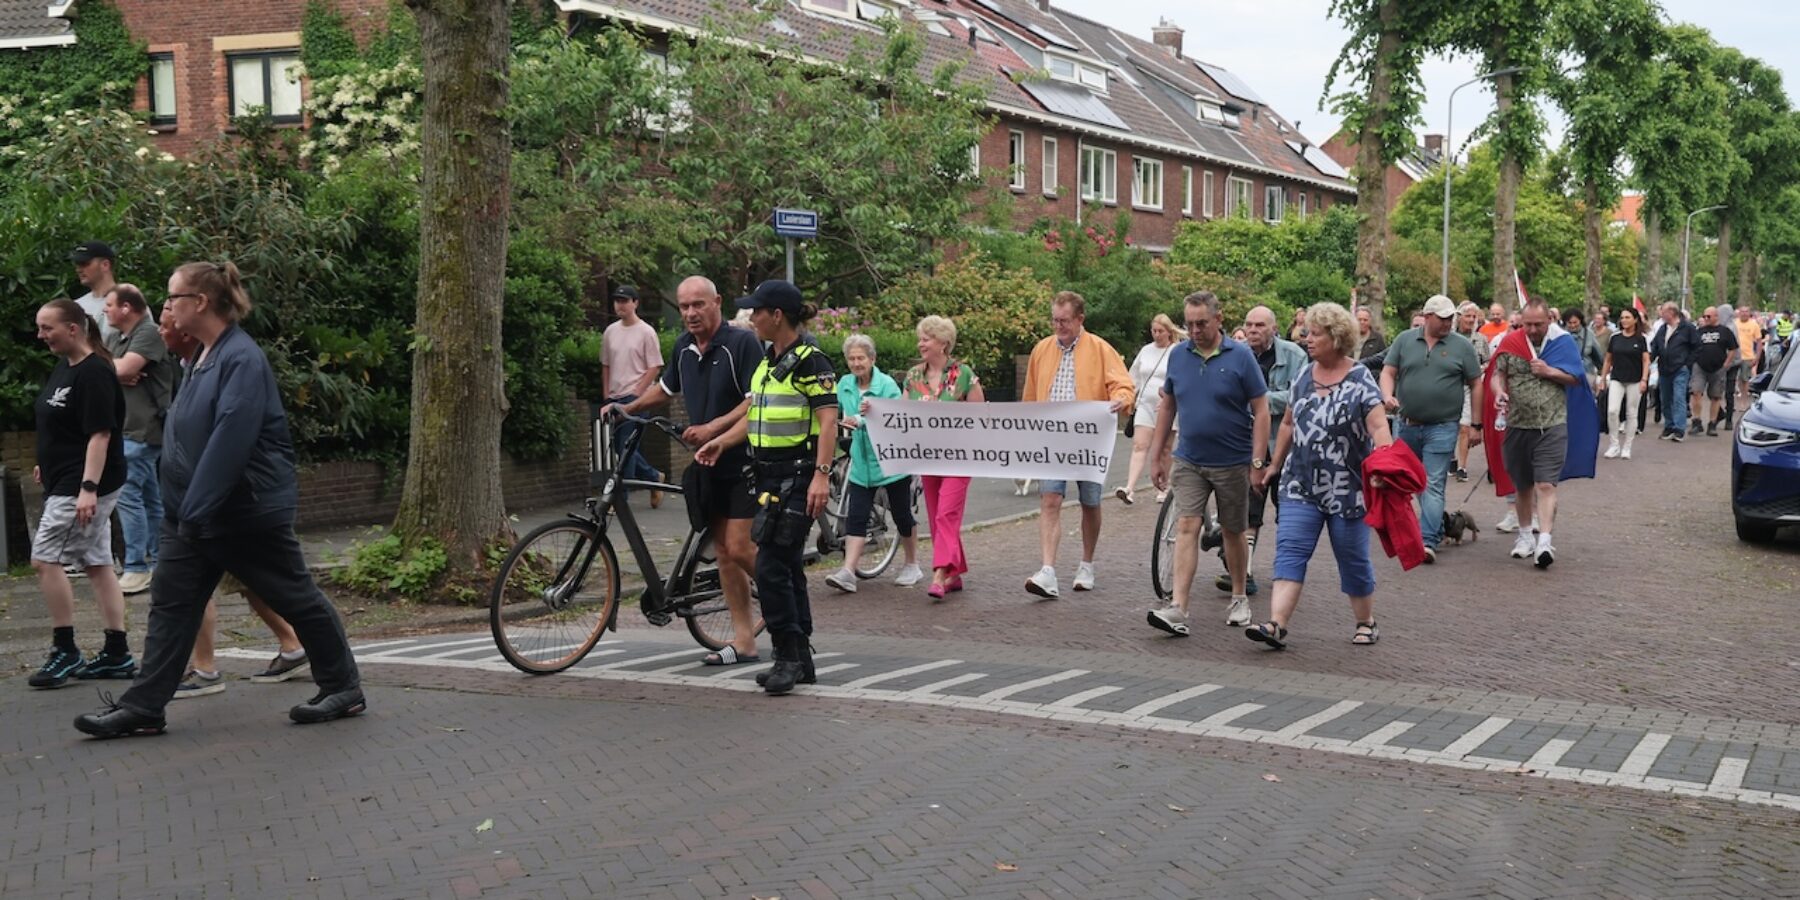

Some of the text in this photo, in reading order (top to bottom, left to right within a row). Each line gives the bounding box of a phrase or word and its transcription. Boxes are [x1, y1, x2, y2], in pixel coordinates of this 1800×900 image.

[882, 412, 1099, 435] Zijn onze vrouwen en
[876, 442, 1109, 474] kinderen nog wel veilig
